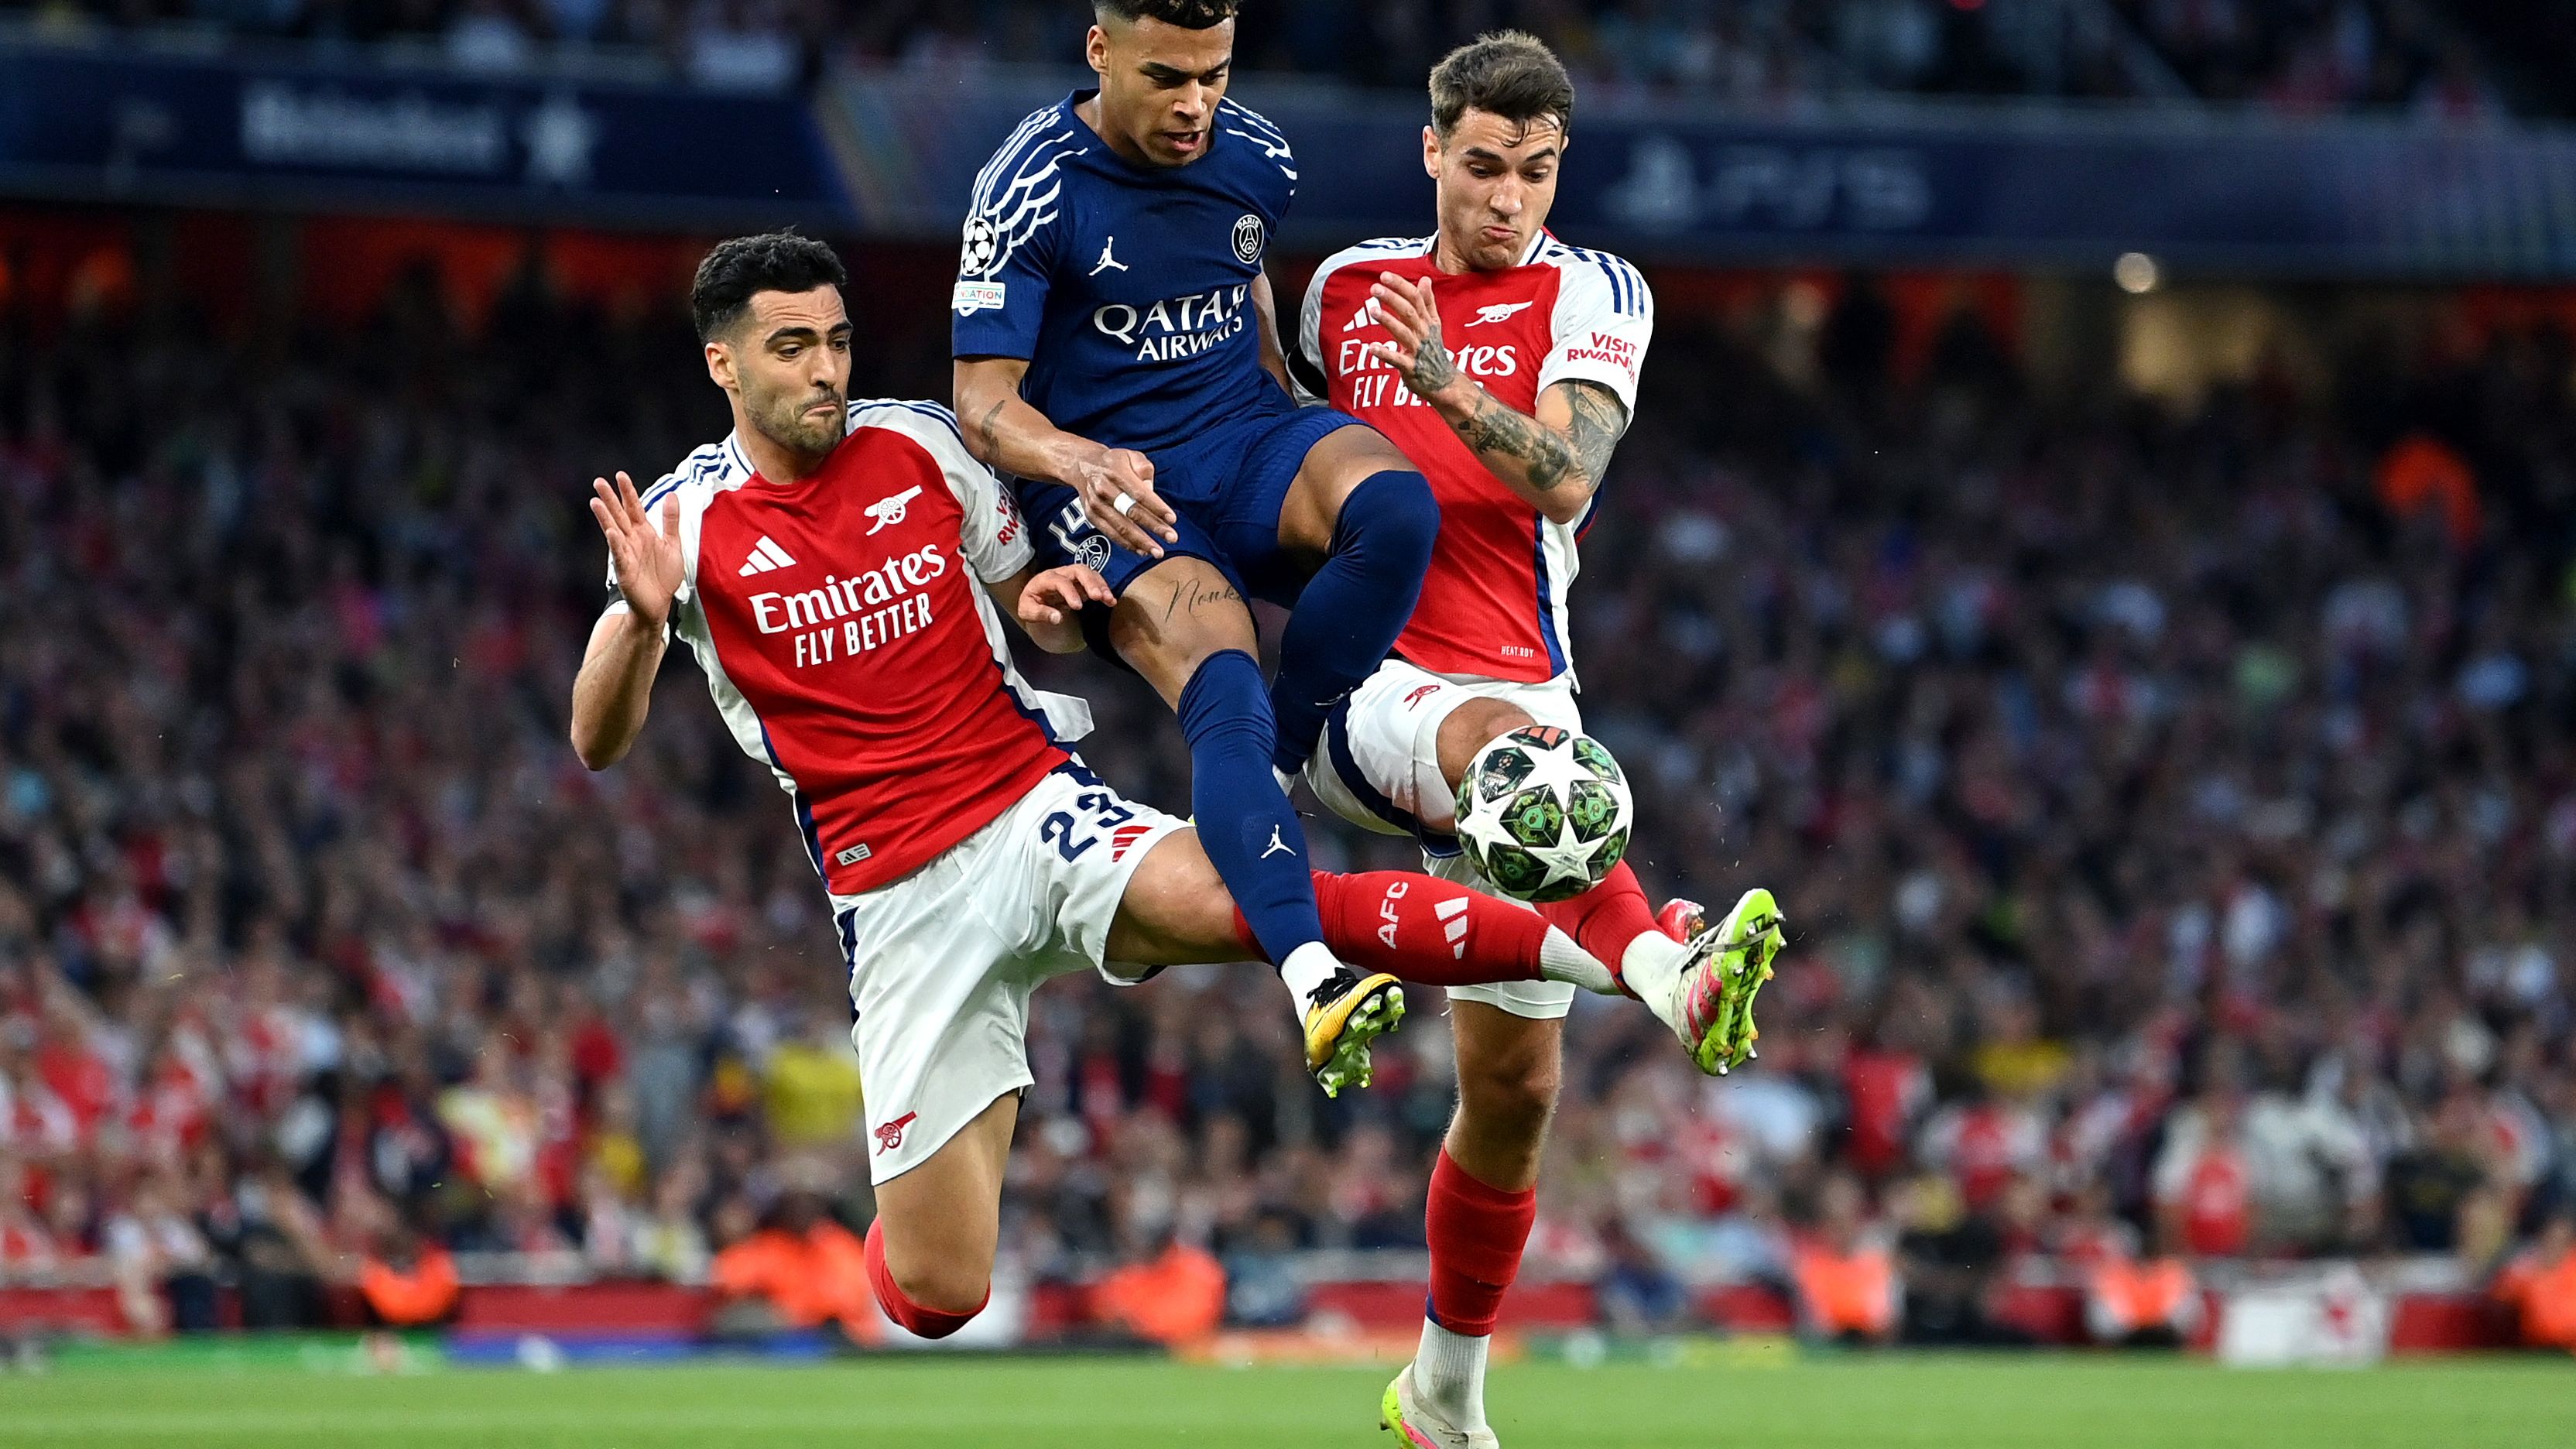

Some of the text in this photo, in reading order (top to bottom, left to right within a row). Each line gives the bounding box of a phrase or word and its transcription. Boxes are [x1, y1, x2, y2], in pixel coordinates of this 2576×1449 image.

[1238, 218, 1259, 230] PARIS
[1339, 338, 1516, 377] Emtes
[1591, 332, 1637, 357] VISIT
[1354, 375, 1390, 410] FLY
[1076, 538, 1098, 561] PARIS
[748, 543, 946, 634] Emirates
[795, 592, 933, 668] FLY BETTER
[1040, 792, 1136, 865] 23
[1378, 882, 1409, 950] AFC
